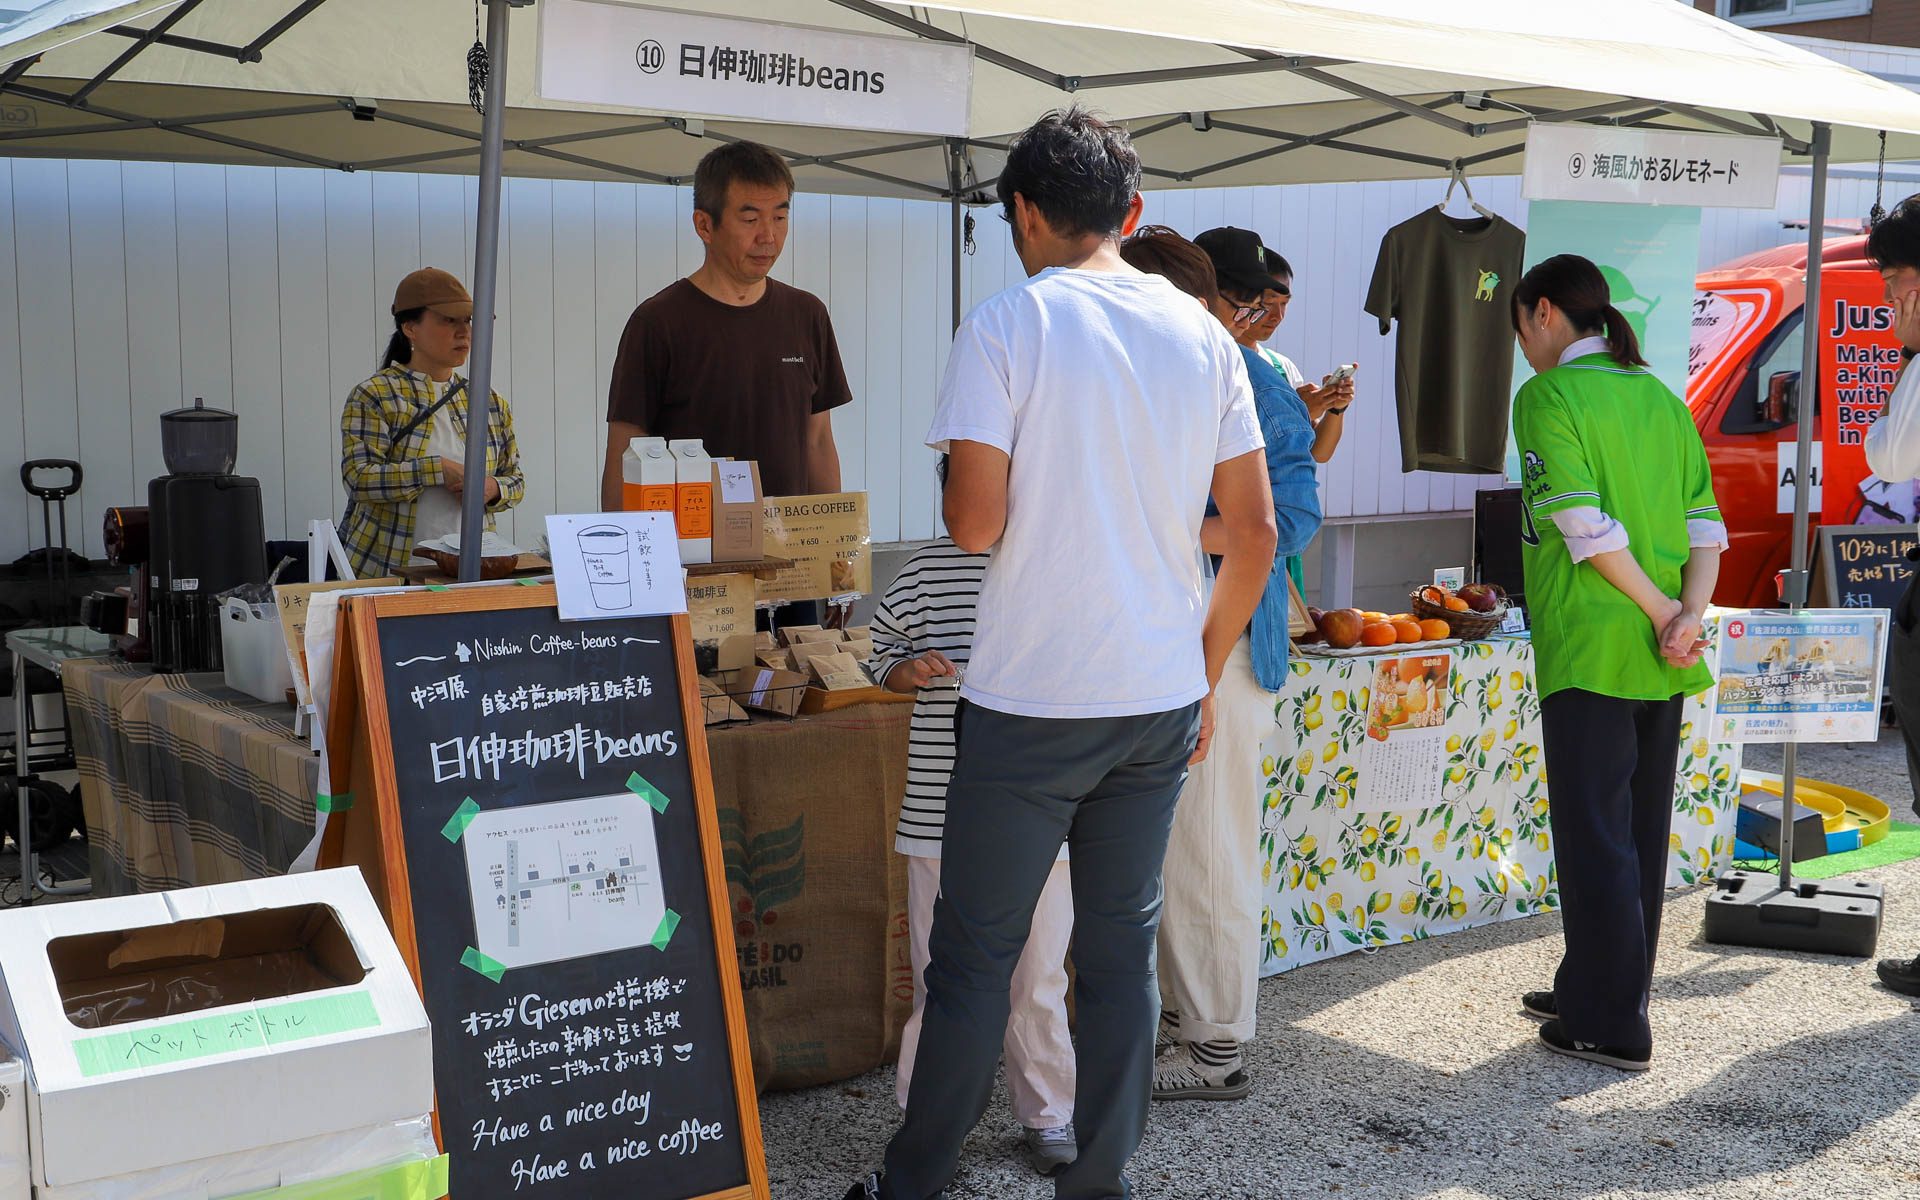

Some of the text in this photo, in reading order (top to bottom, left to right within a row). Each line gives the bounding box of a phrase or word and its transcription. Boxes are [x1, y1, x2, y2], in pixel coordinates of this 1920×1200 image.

[679, 42, 886, 95] 日伸珈琲beans
[1591, 152, 1739, 185] 海風かおるレモネード
[1831, 299, 1896, 338] Jus
[1837, 344, 1899, 363] Make
[1837, 386, 1891, 404] with
[1839, 426, 1860, 445] in
[784, 505, 809, 516] BAG
[812, 502, 856, 515] COFFEE
[715, 607, 734, 615] ¥850
[709, 623, 734, 632] ¥1,600
[474, 631, 617, 663] Nisshin Coffee-beans
[410, 674, 653, 717] 中河原 自家焙煎珈琲豆販売店
[430, 722, 679, 783] 日伸珈琲beans
[472, 1089, 652, 1151] Have a nice day
[510, 1118, 724, 1192] Have a nice coffee
